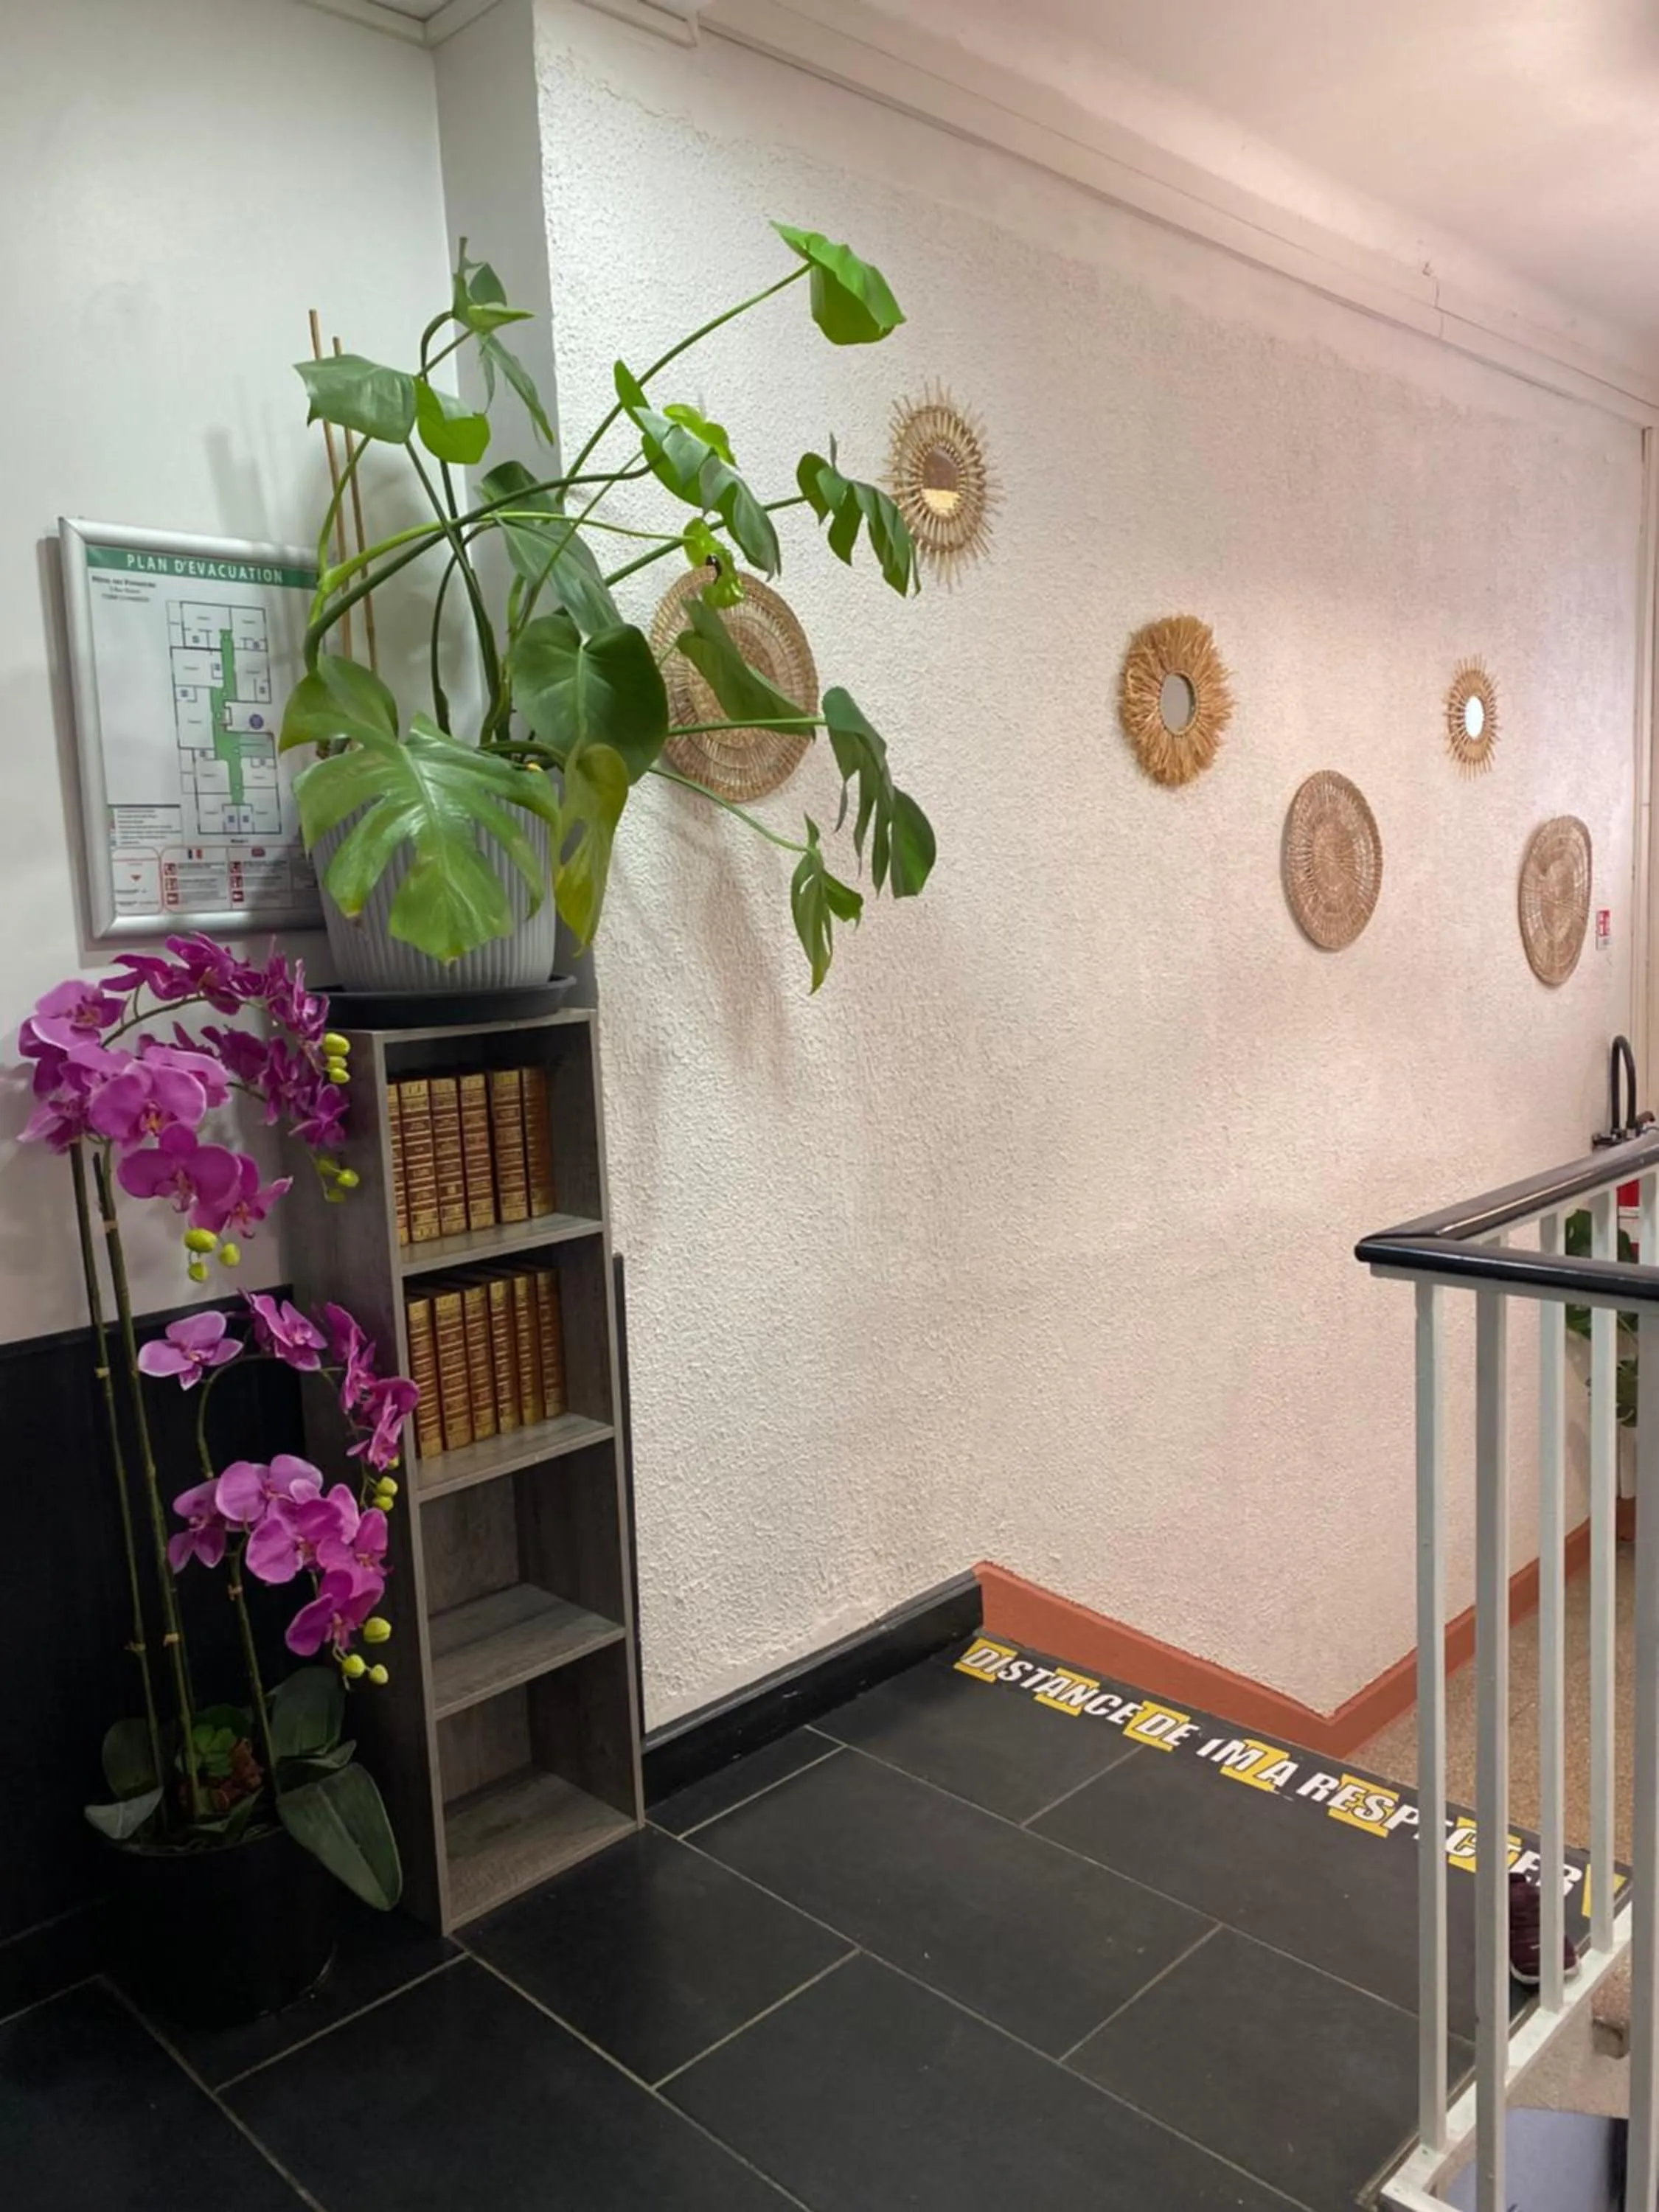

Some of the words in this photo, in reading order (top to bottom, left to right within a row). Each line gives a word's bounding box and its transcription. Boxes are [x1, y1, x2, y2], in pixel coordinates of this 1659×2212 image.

[126, 554, 168, 571] PLAN
[174, 560, 284, 584] D'EVACUATION
[961, 1647, 1144, 1725] DISTANCE
[1135, 1712, 1200, 1747] DE
